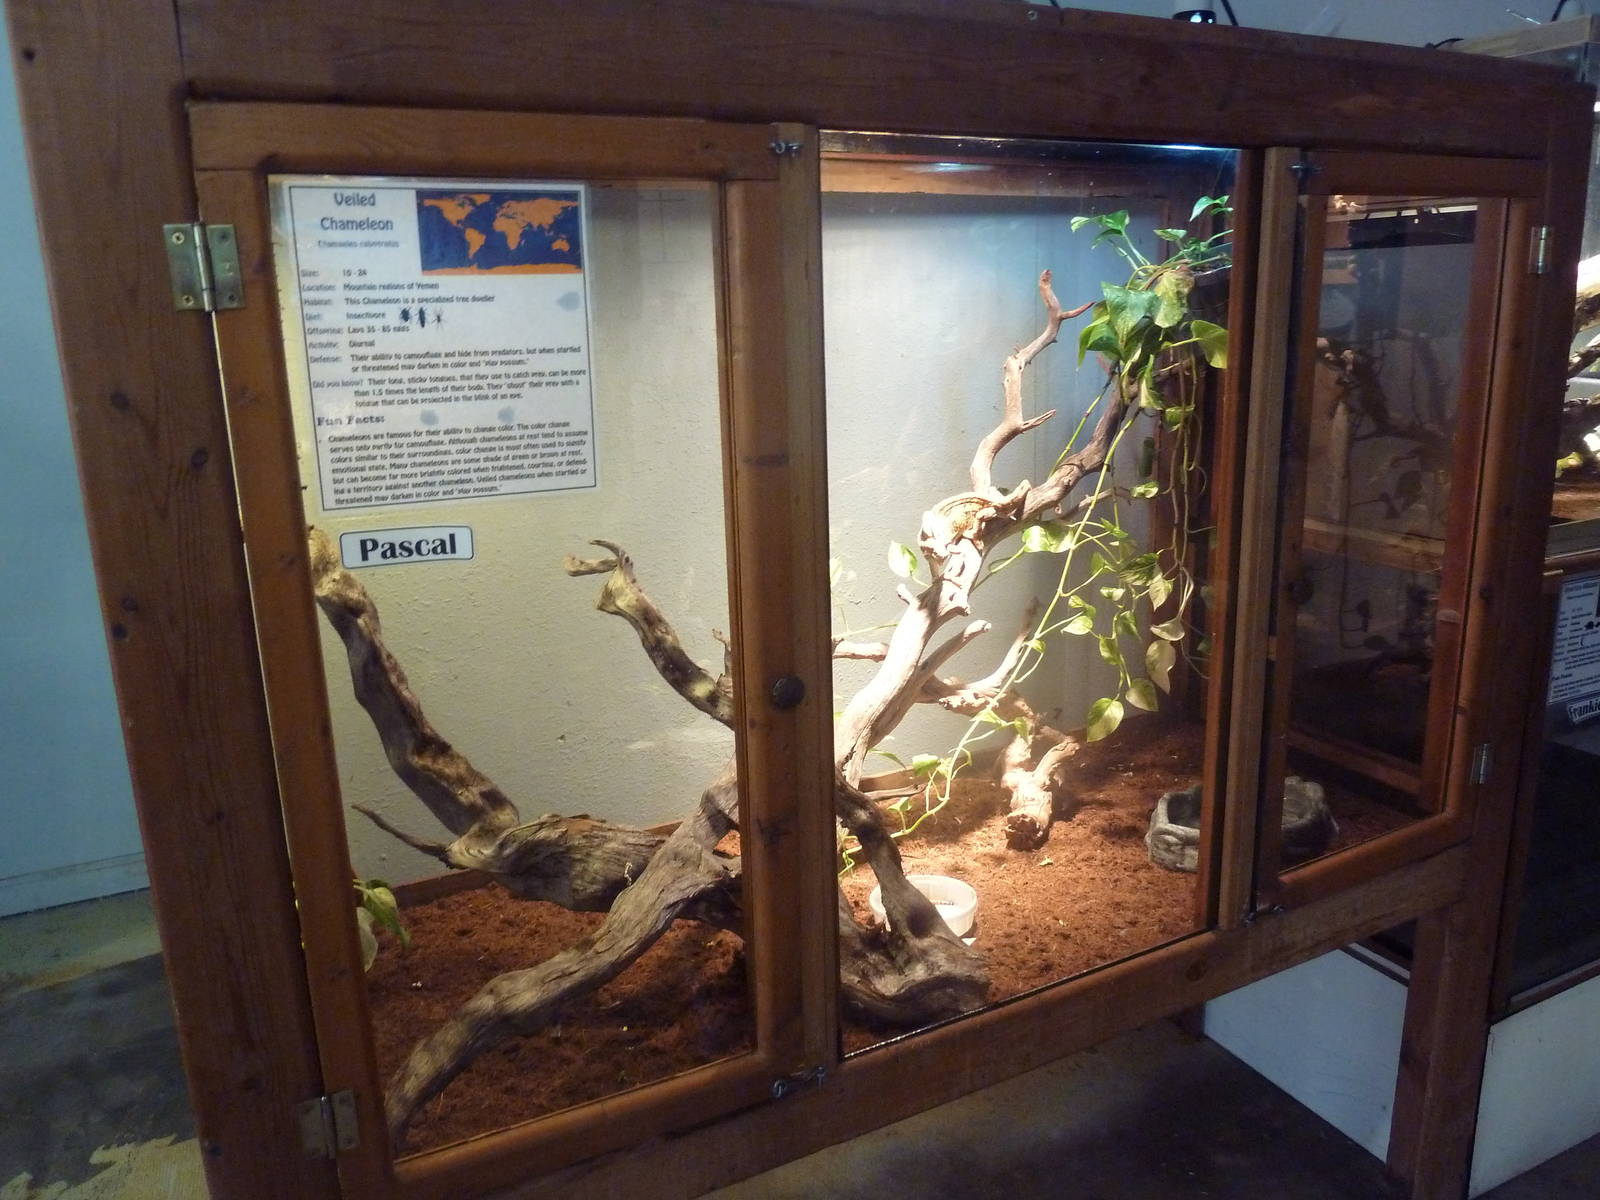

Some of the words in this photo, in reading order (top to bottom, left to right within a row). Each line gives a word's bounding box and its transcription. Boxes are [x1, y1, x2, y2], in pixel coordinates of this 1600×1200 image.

[334, 192, 376, 206] Veiled
[320, 217, 394, 231] Chameleon
[360, 534, 456, 562] Pascal
